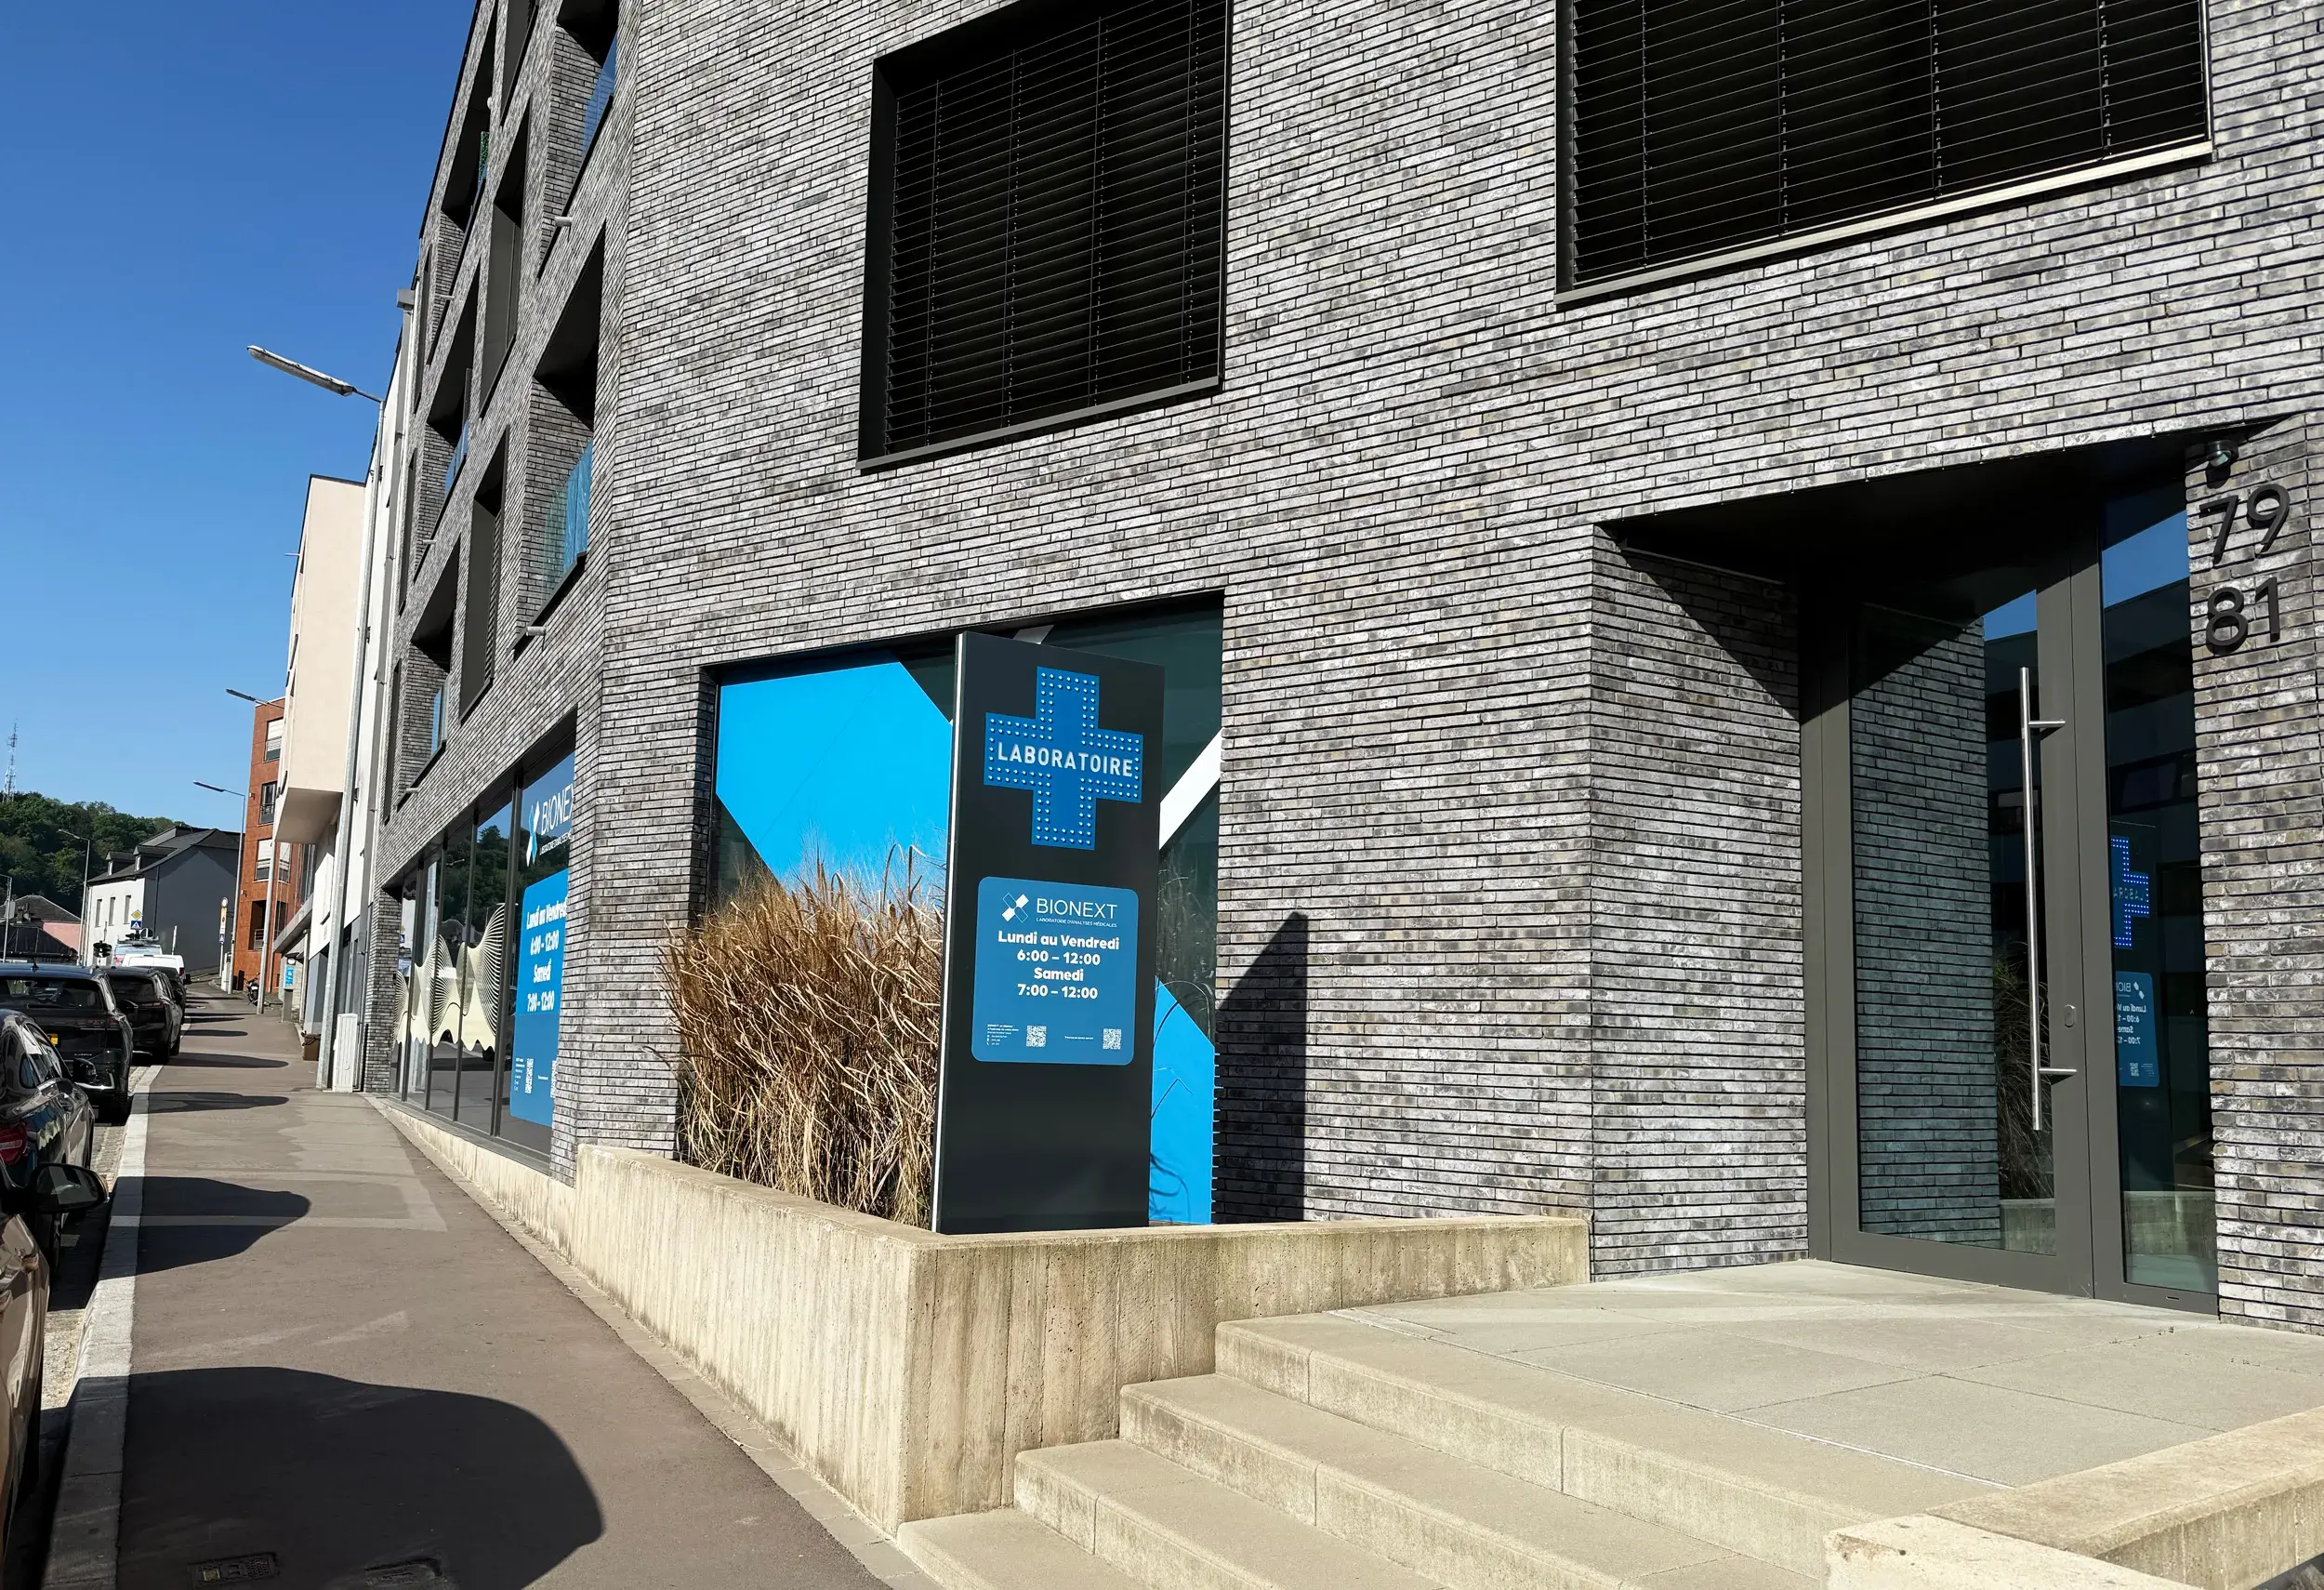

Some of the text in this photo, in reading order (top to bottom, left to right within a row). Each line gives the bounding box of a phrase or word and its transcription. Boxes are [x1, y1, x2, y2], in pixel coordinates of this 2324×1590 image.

[2199, 484, 2291, 563] 79
[2206, 576, 2280, 656] 81
[997, 741, 1133, 777] LABORATOIRE
[1037, 897, 1118, 920] BIONEXT
[997, 930, 1120, 950] Lundi au Vendredi
[1017, 949, 1049, 962] 6:00
[1063, 952, 1101, 966] 12:00
[1034, 967, 1084, 982] Samedi
[1017, 983, 1049, 997] 7:00
[1062, 986, 1098, 1000] 12:00
